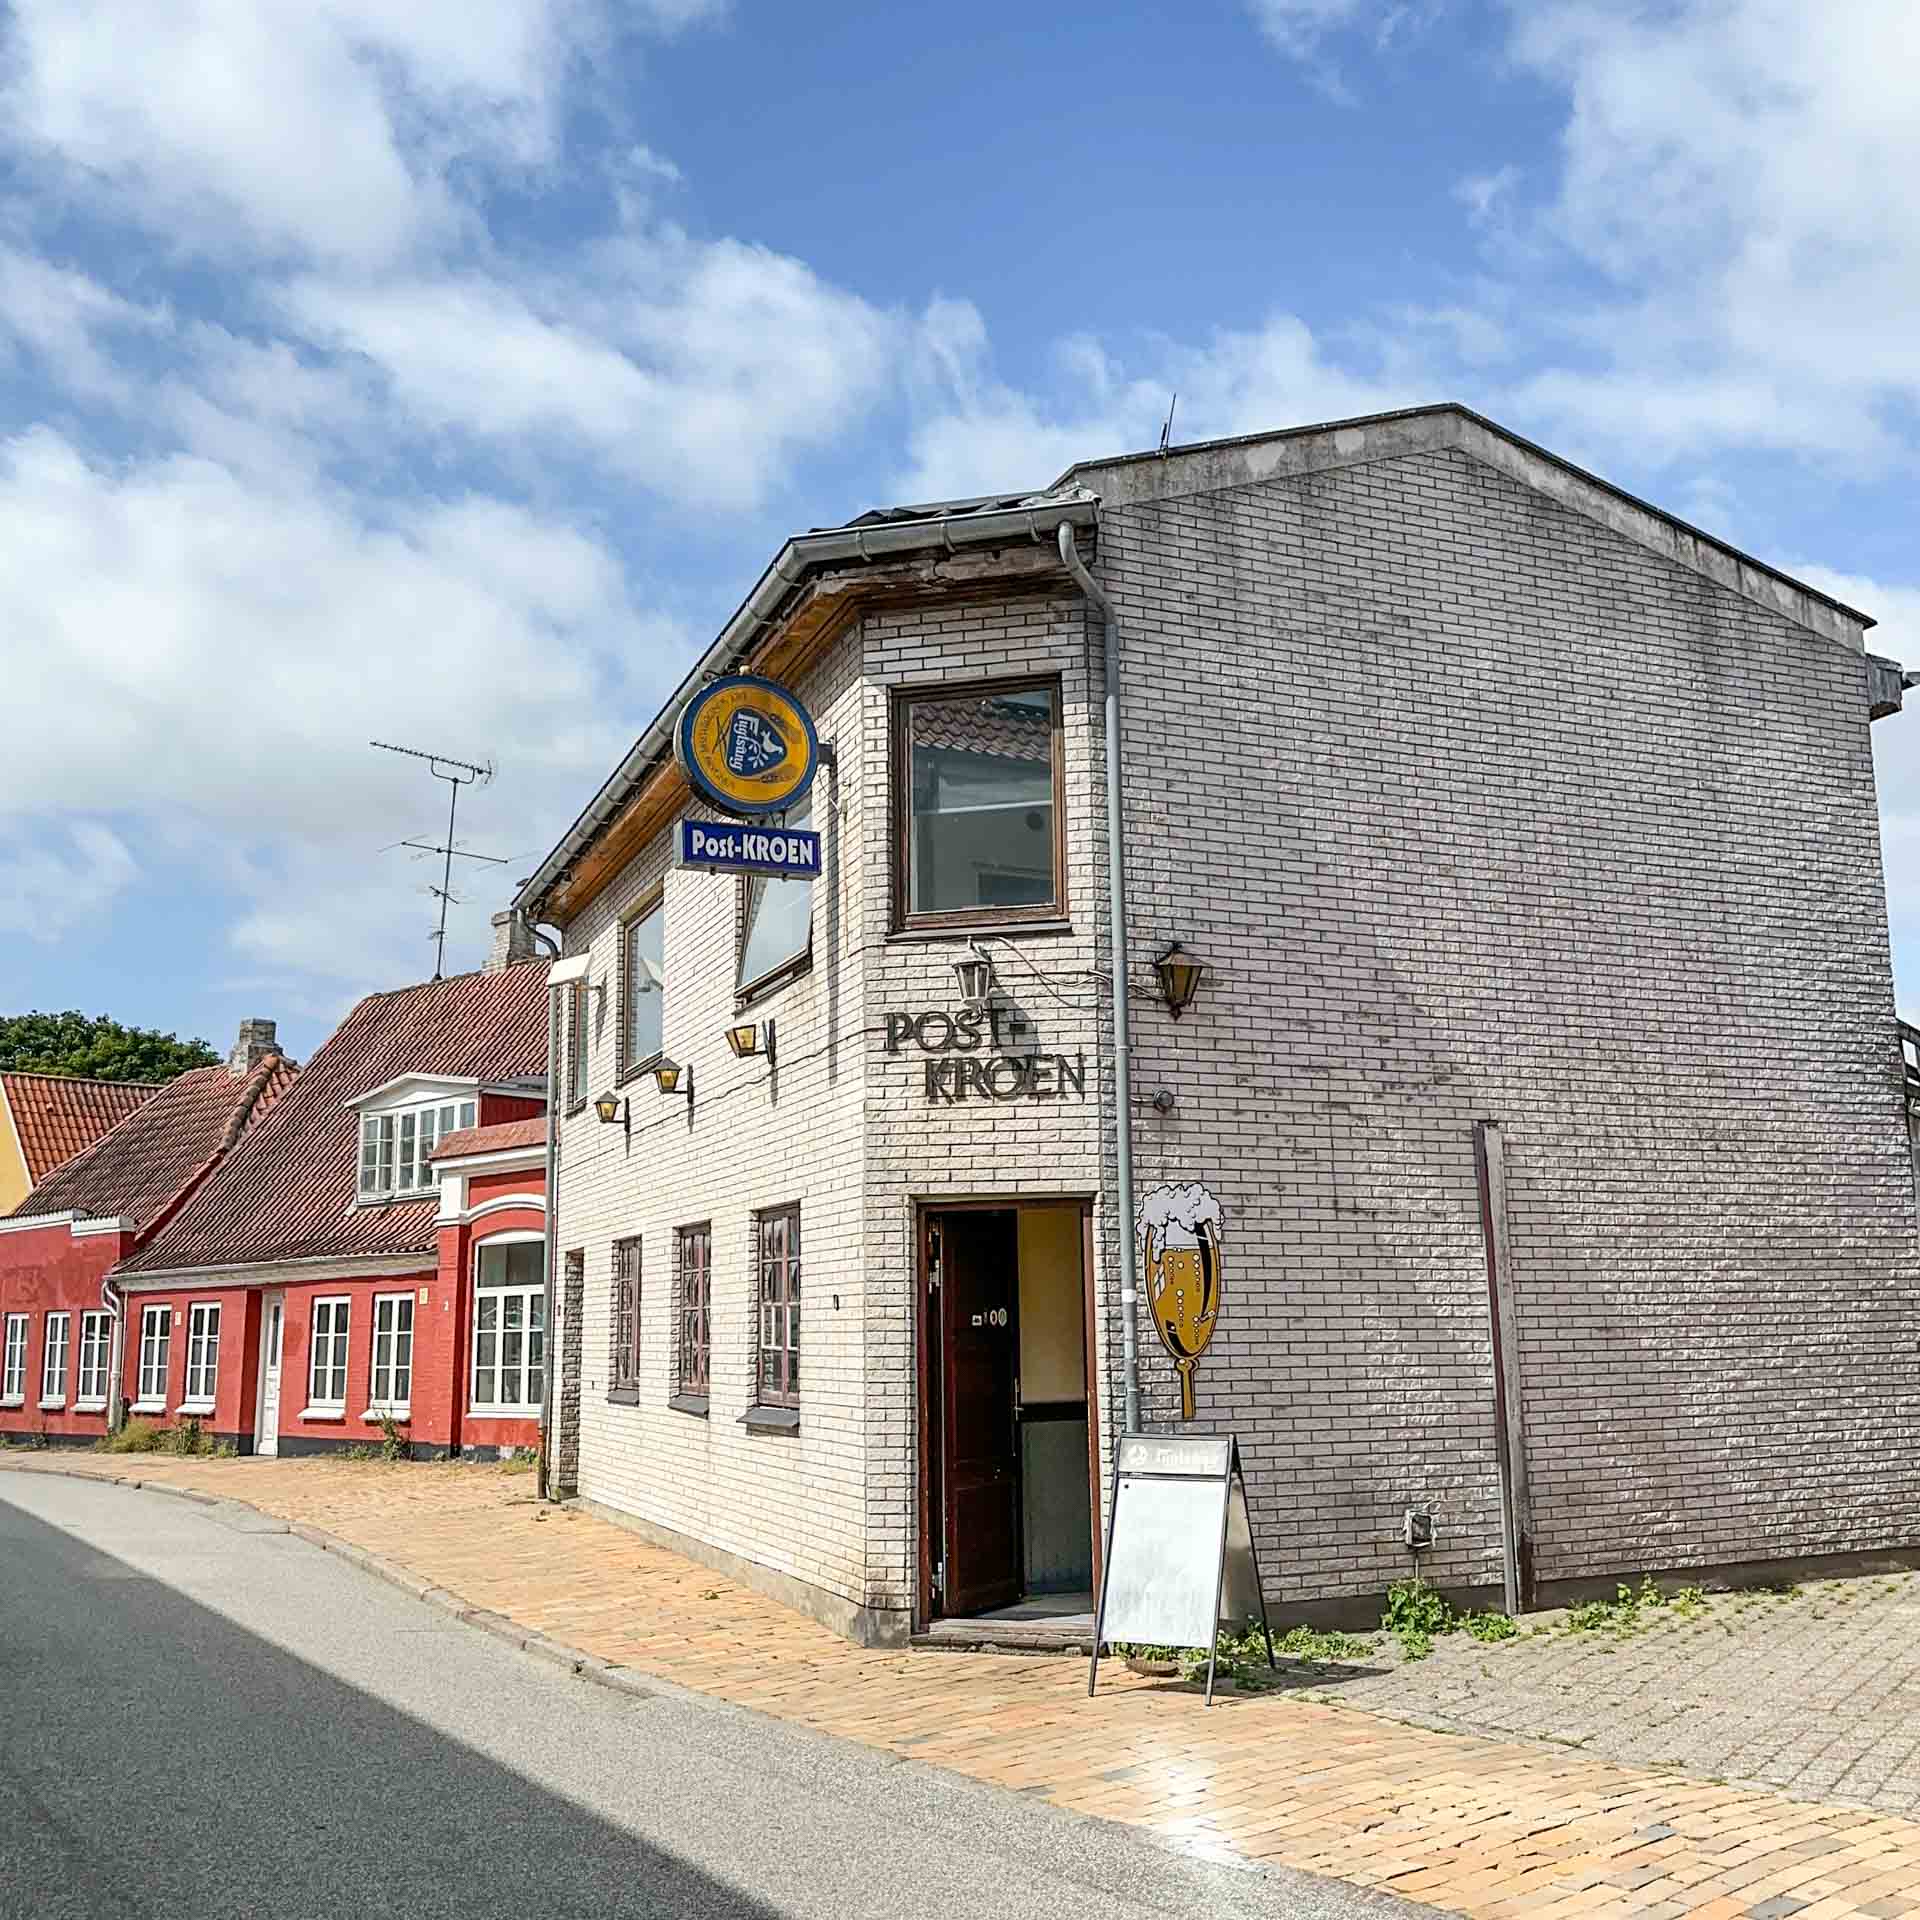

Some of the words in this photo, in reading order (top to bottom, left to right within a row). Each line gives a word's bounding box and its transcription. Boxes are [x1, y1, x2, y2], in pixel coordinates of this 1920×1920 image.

[729, 712, 760, 772] Fuglsang
[691, 829, 814, 865] Post-KROEN
[925, 1053, 1087, 1104] KROEN
